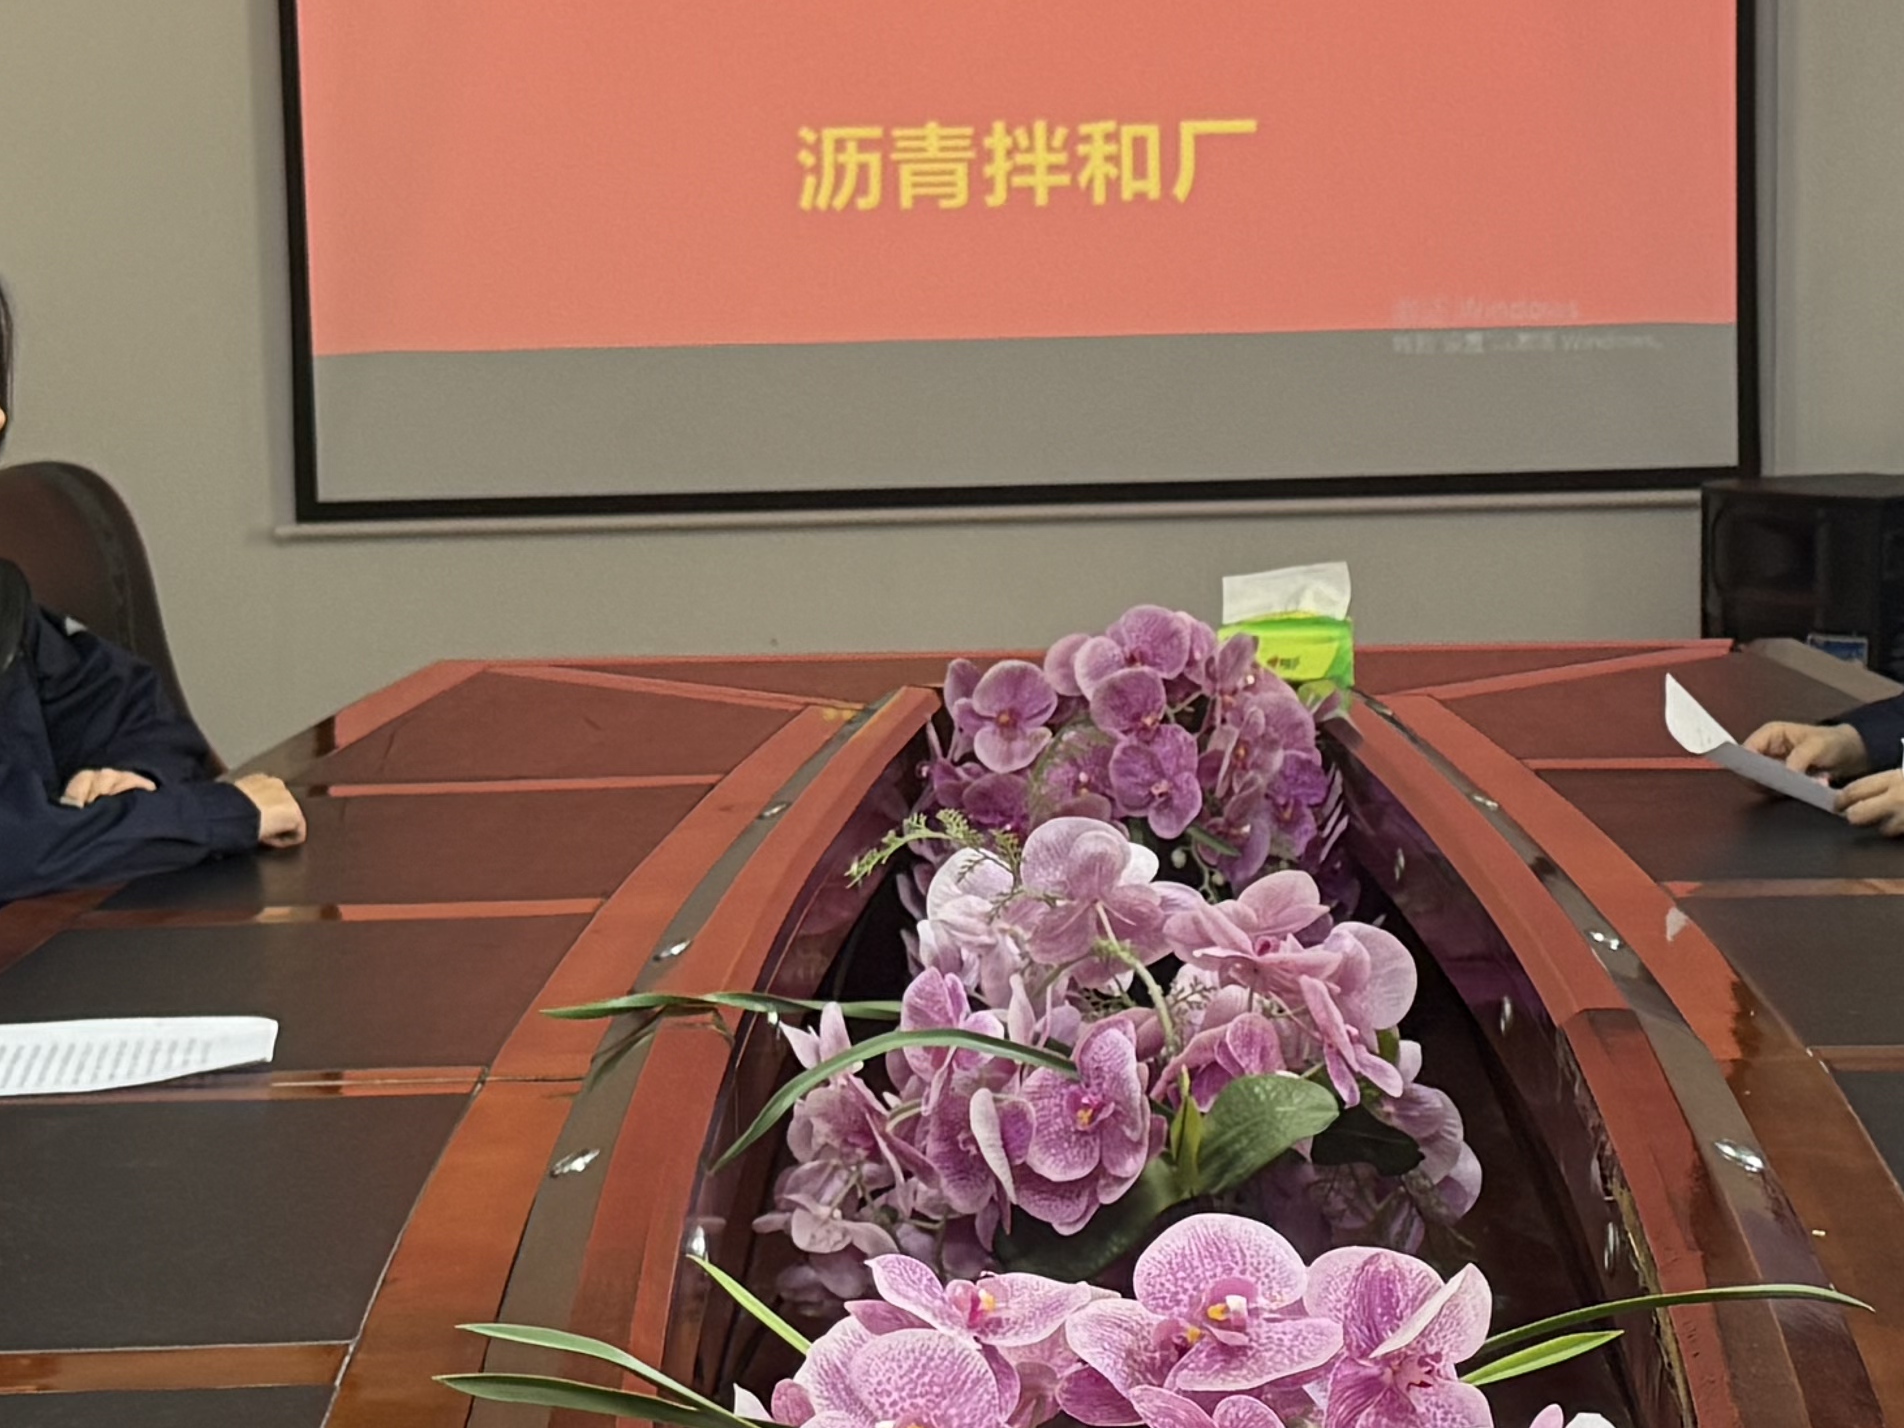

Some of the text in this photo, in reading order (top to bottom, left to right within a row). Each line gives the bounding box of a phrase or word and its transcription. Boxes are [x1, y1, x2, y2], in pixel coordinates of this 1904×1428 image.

[796, 117, 1259, 215] 沥青拌和厂
